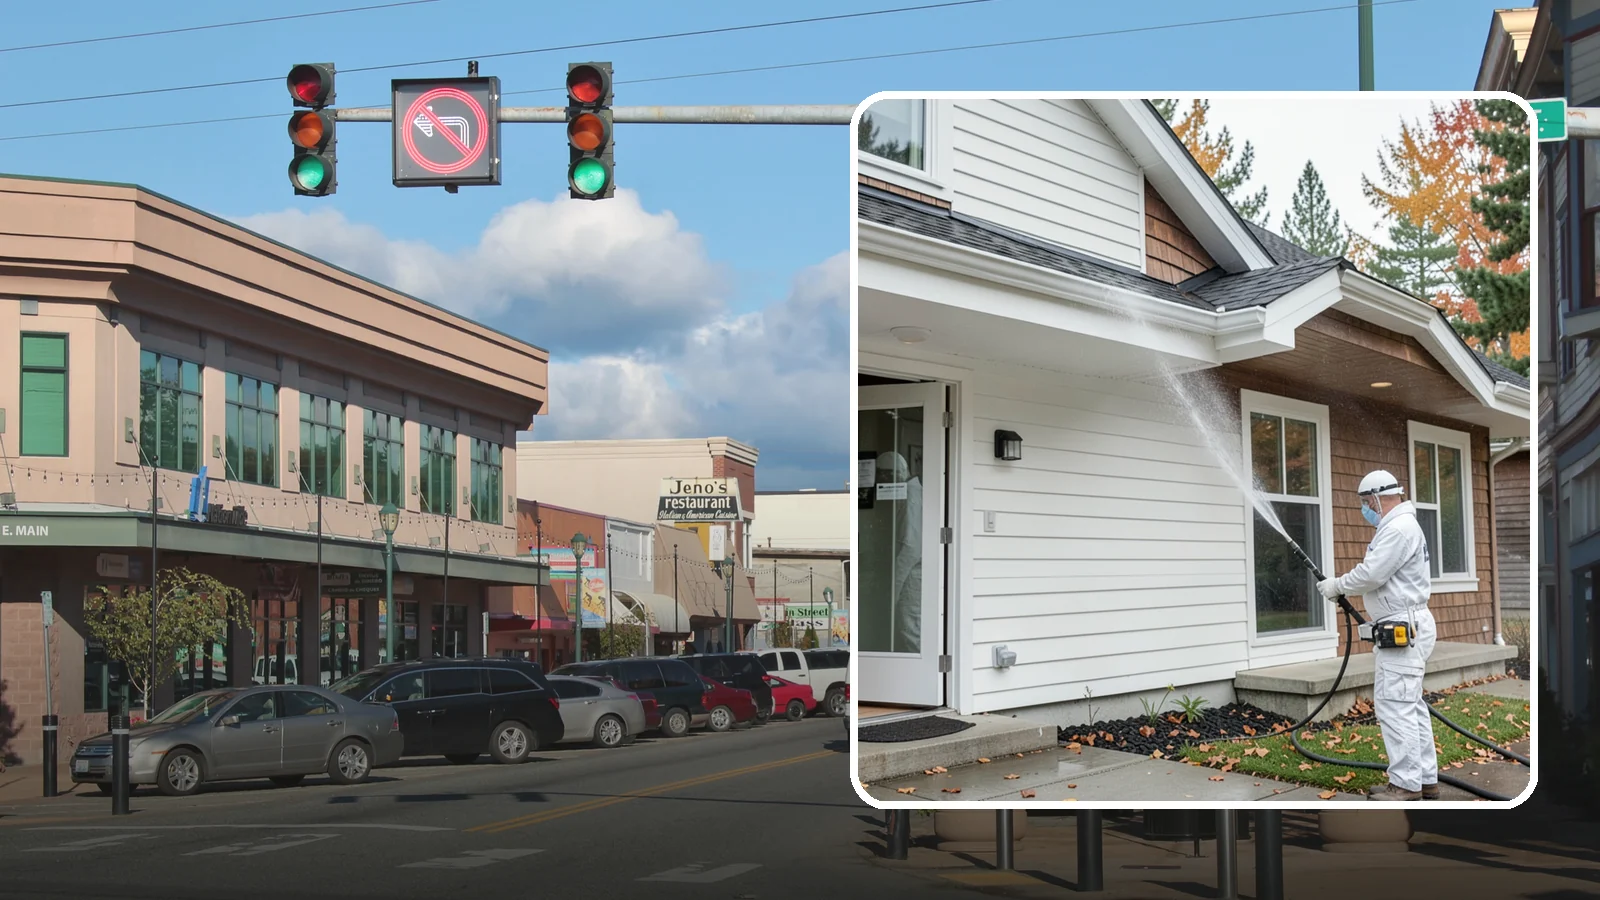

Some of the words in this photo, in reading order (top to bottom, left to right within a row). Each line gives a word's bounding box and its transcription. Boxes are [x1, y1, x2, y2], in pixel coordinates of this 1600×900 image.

[670, 480, 728, 494] Jeno's
[665, 496, 731, 509] restaurant
[686, 510, 714, 519] American
[715, 509, 737, 519] Cuisine
[2, 525, 13, 536] E.
[15, 525, 49, 536] MAIN
[797, 607, 828, 617] Street
